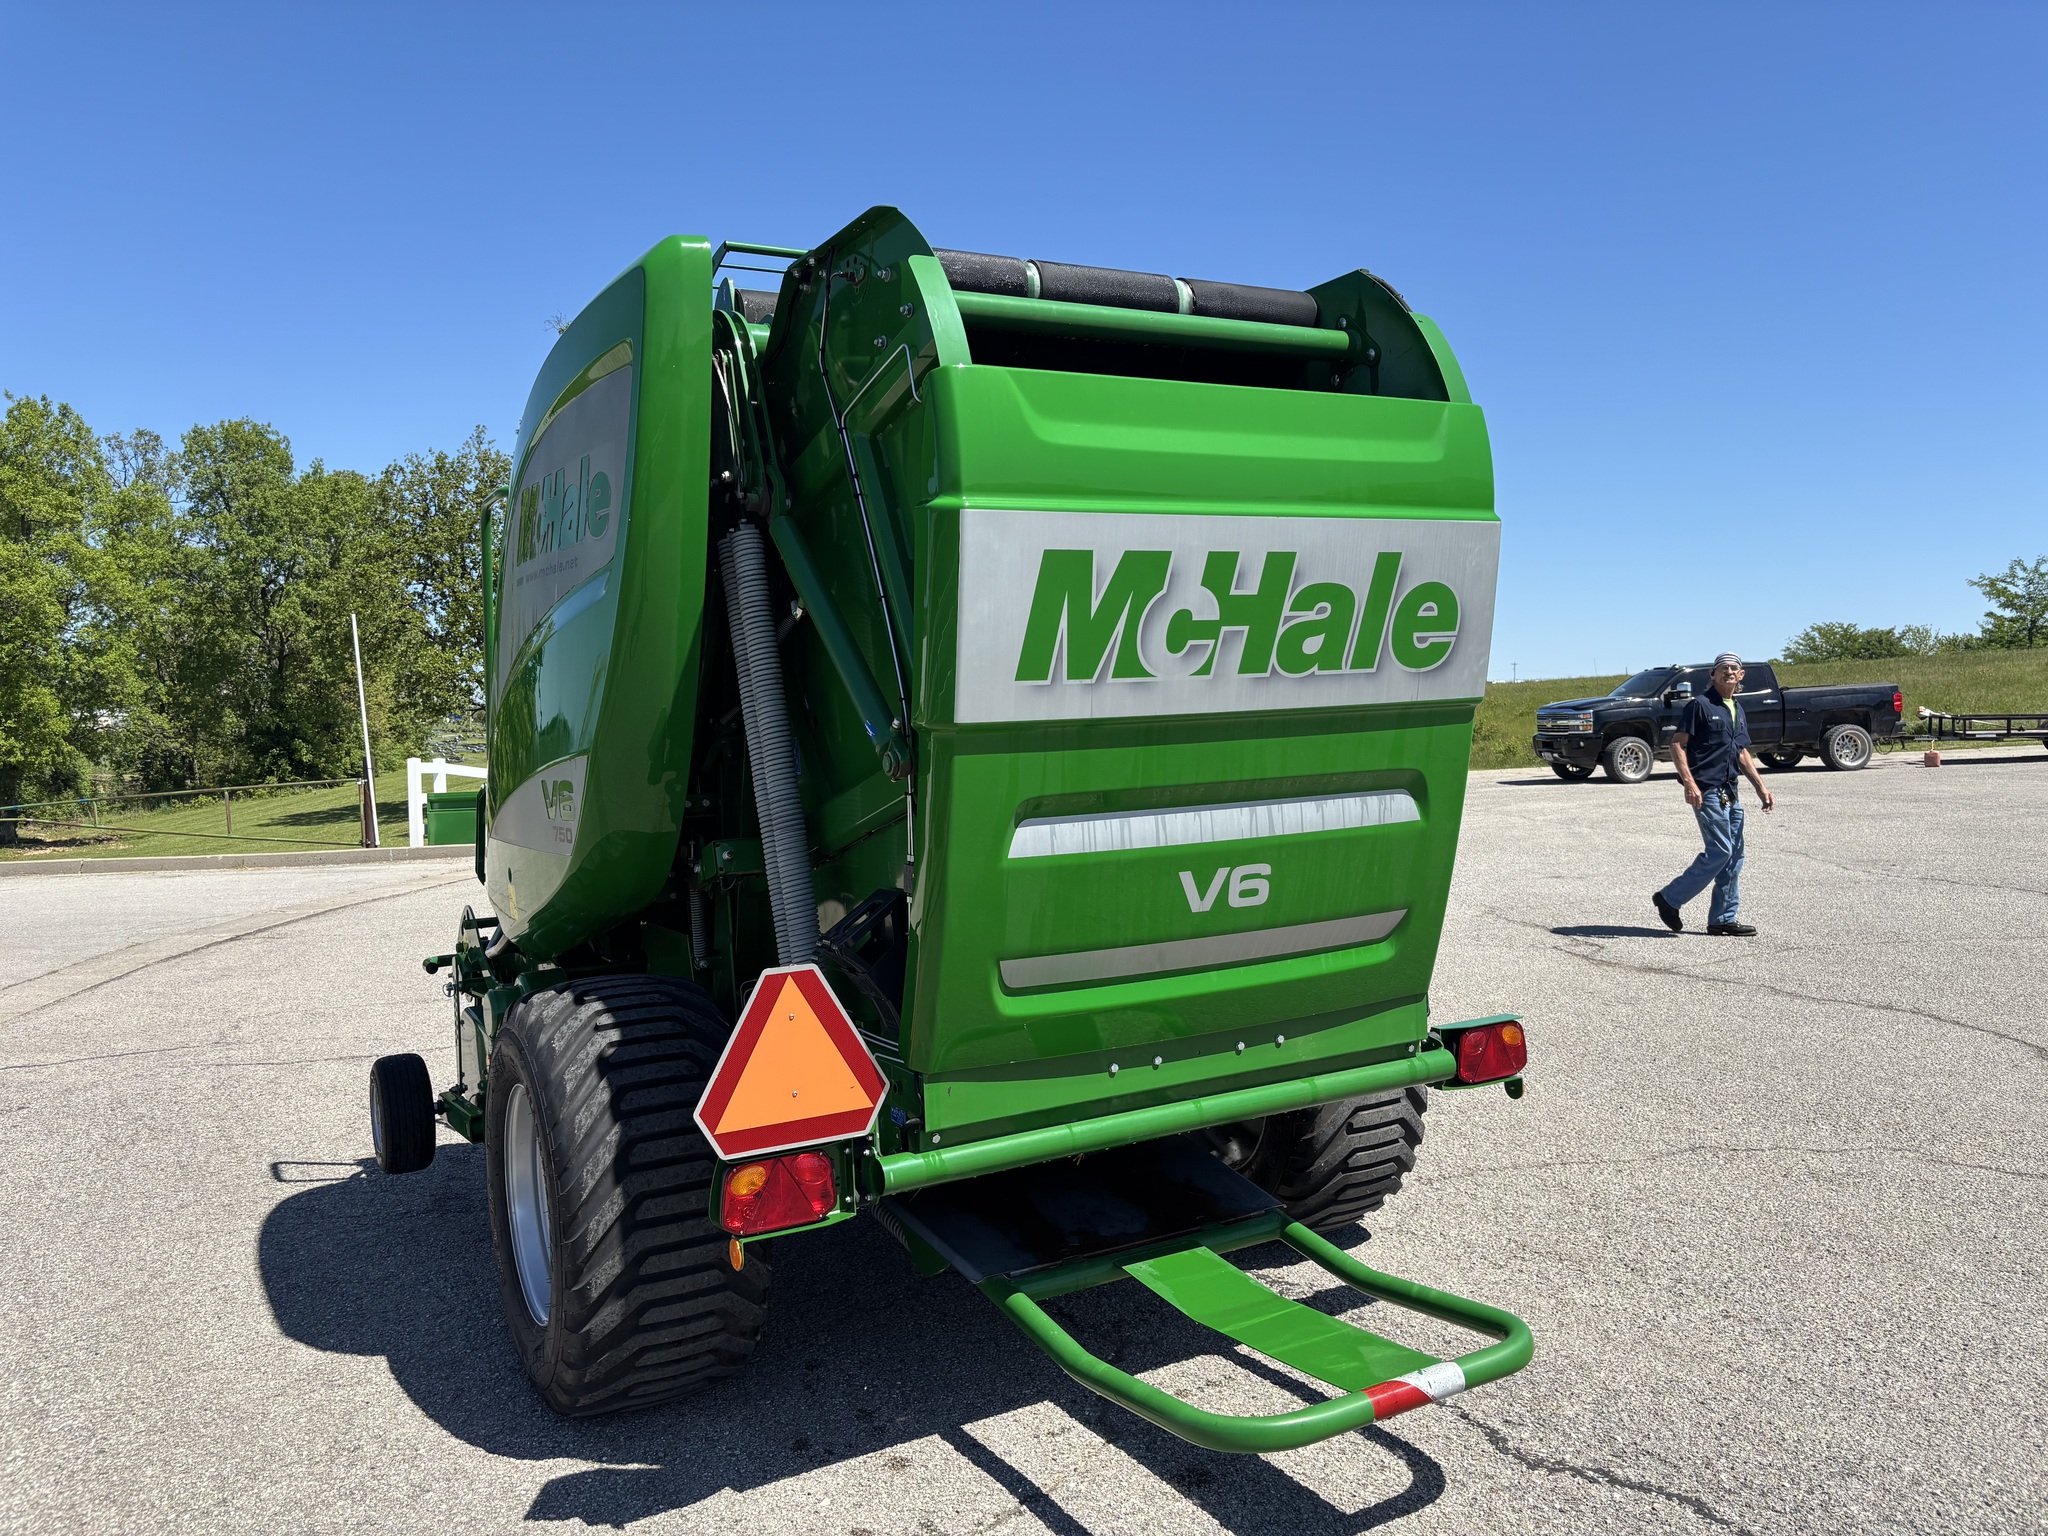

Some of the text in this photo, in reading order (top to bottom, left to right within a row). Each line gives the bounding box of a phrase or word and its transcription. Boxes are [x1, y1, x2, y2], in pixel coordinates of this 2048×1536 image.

[517, 455, 612, 567] McHale
[1014, 549, 1460, 685] McHale
[541, 780, 575, 821] V6
[552, 826, 573, 844] 750
[1179, 863, 1272, 913] V6
